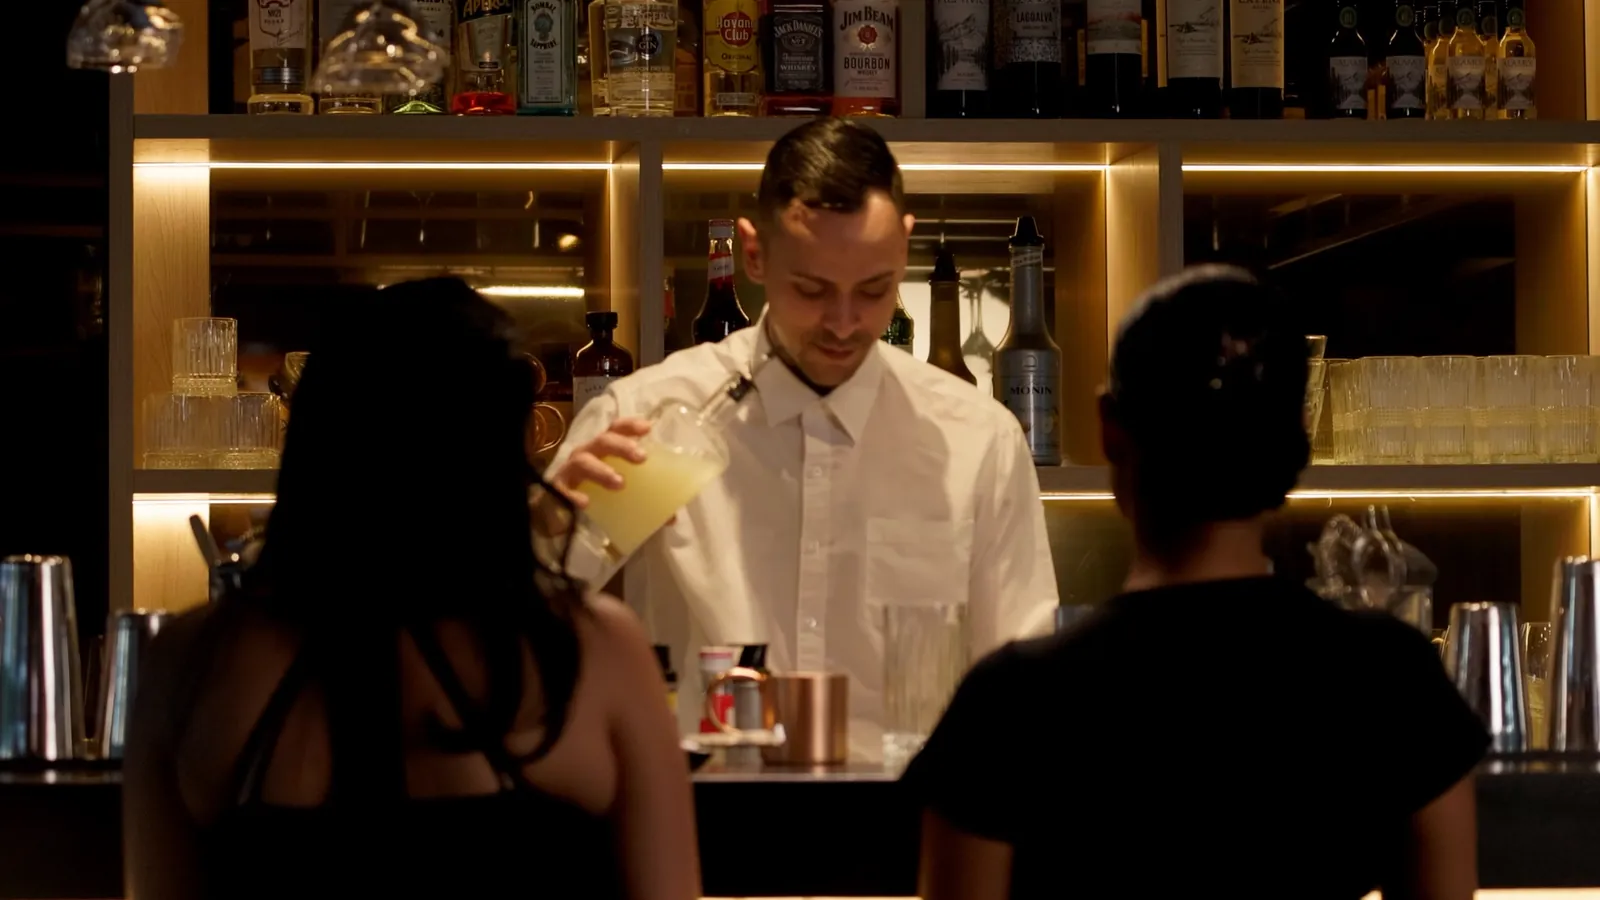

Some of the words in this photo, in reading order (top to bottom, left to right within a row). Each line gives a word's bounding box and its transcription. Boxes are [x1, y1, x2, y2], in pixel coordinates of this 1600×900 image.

[531, 1, 556, 13] BOMBAY
[839, 10, 862, 31] JIM
[863, 6, 894, 32] BEAM
[724, 28, 749, 41] Club
[773, 21, 794, 38] JACK
[529, 38, 558, 50] SAPPHIRE
[638, 41, 657, 50] GIN
[780, 64, 817, 72] WHISKEY
[843, 57, 891, 70] BOURBON
[1009, 386, 1053, 397] MONIN
